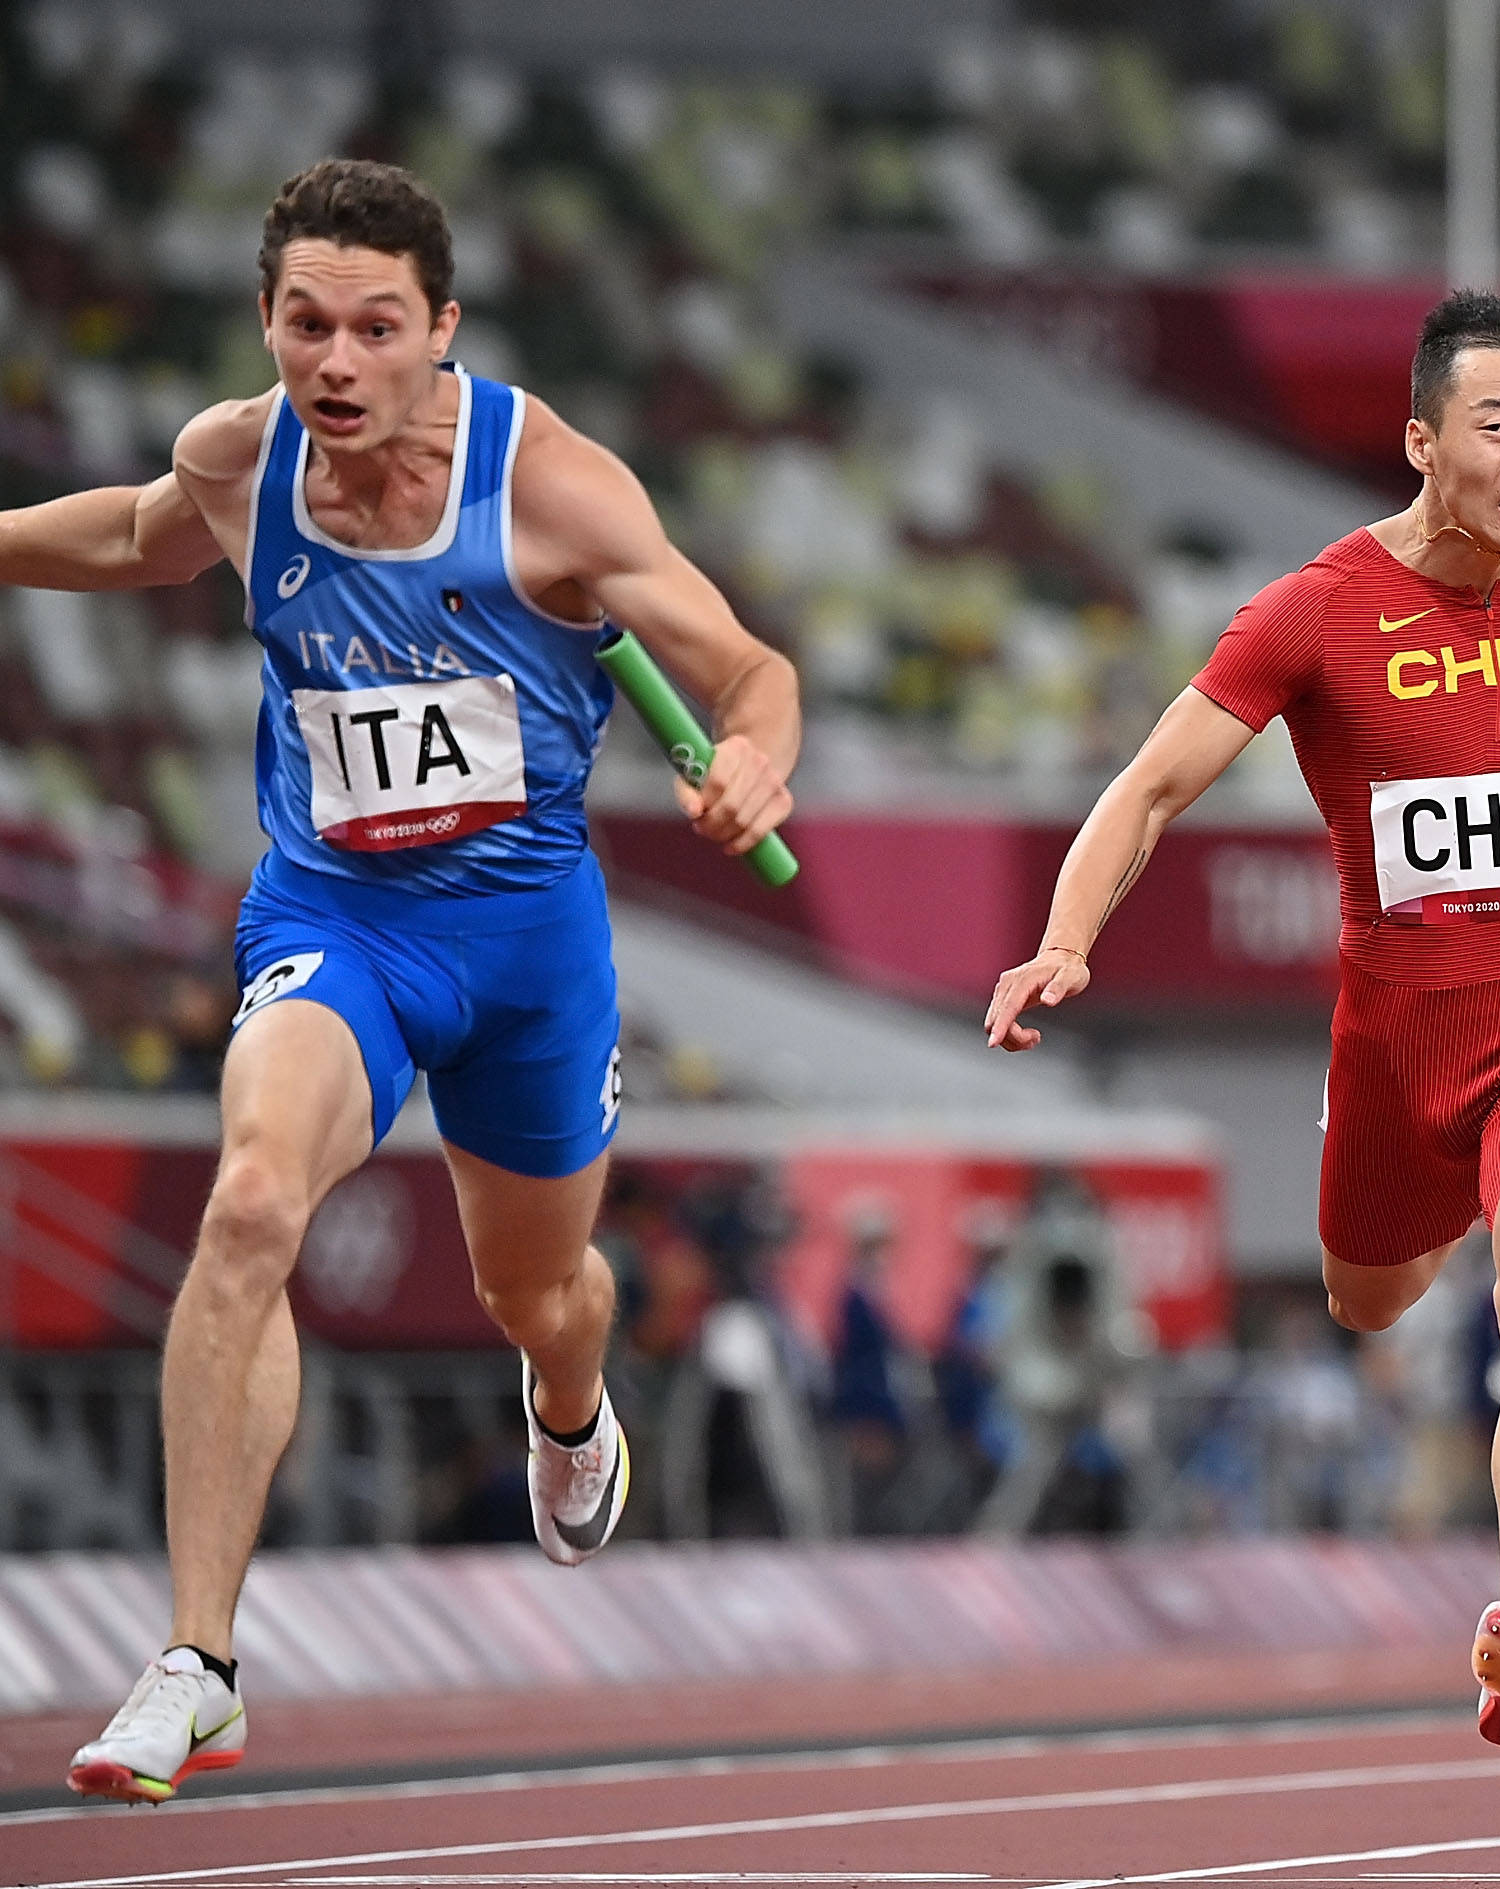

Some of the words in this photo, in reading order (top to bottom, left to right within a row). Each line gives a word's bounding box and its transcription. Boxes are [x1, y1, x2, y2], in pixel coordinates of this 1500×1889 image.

[298, 631, 471, 678] ITALIA
[330, 703, 472, 791] ITA
[1442, 903, 1474, 914] TOKYO
[1475, 901, 1500, 912] 2020
